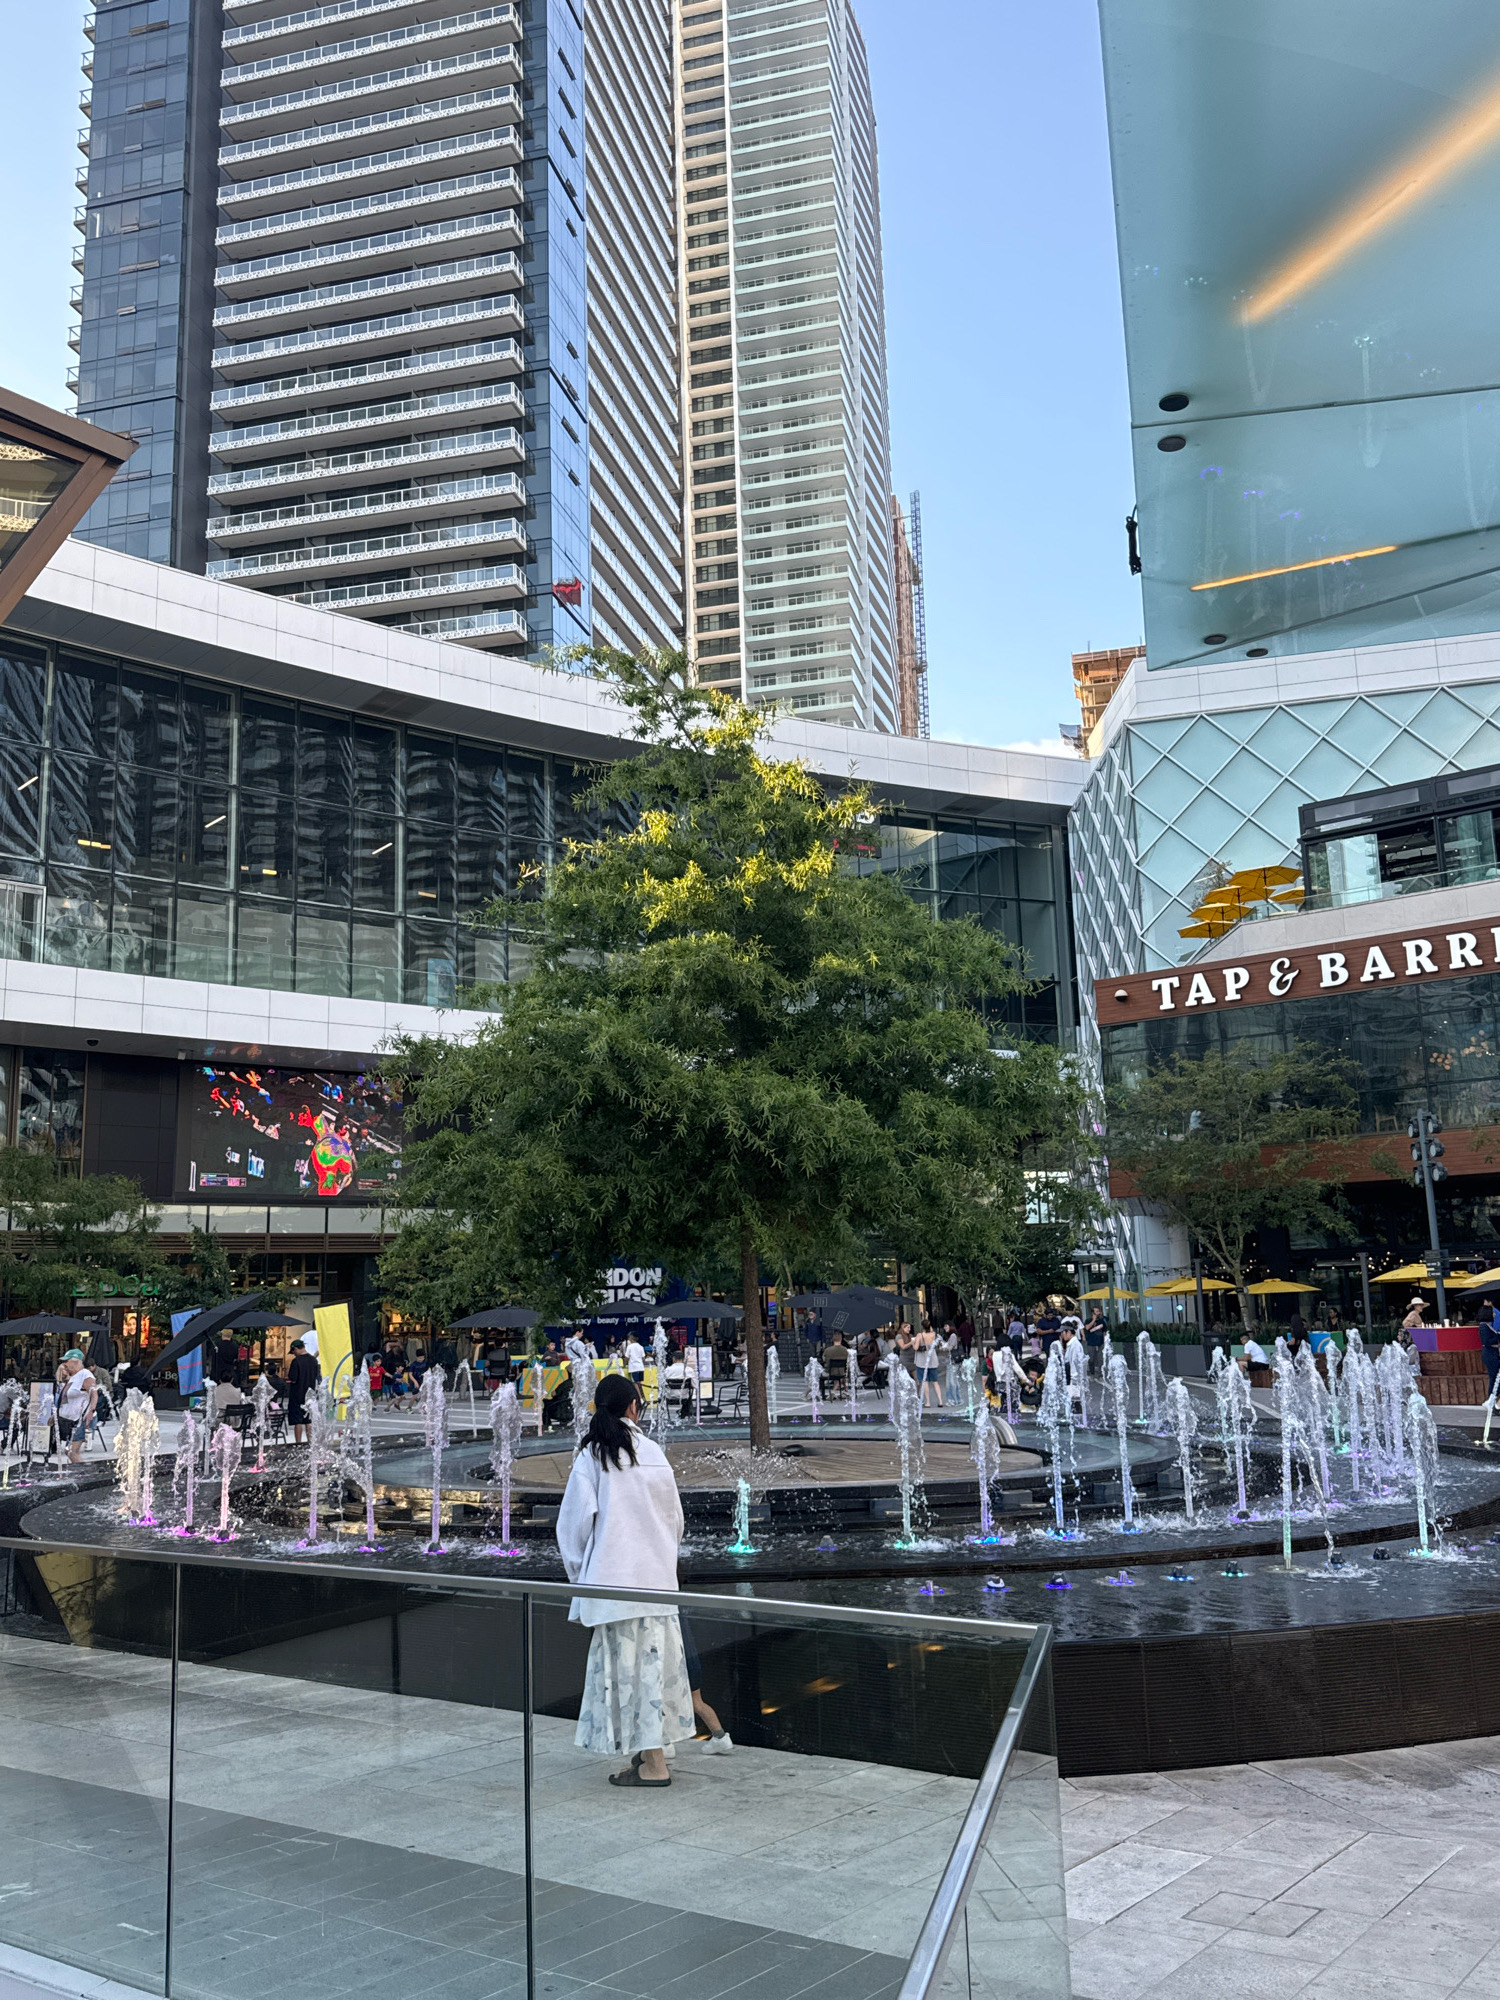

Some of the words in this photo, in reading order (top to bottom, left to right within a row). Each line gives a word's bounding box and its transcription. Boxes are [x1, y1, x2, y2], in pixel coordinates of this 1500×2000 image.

[1151, 966, 1251, 1011] TAP
[1267, 957, 1300, 997] &
[597, 1316, 620, 1326] beauty
